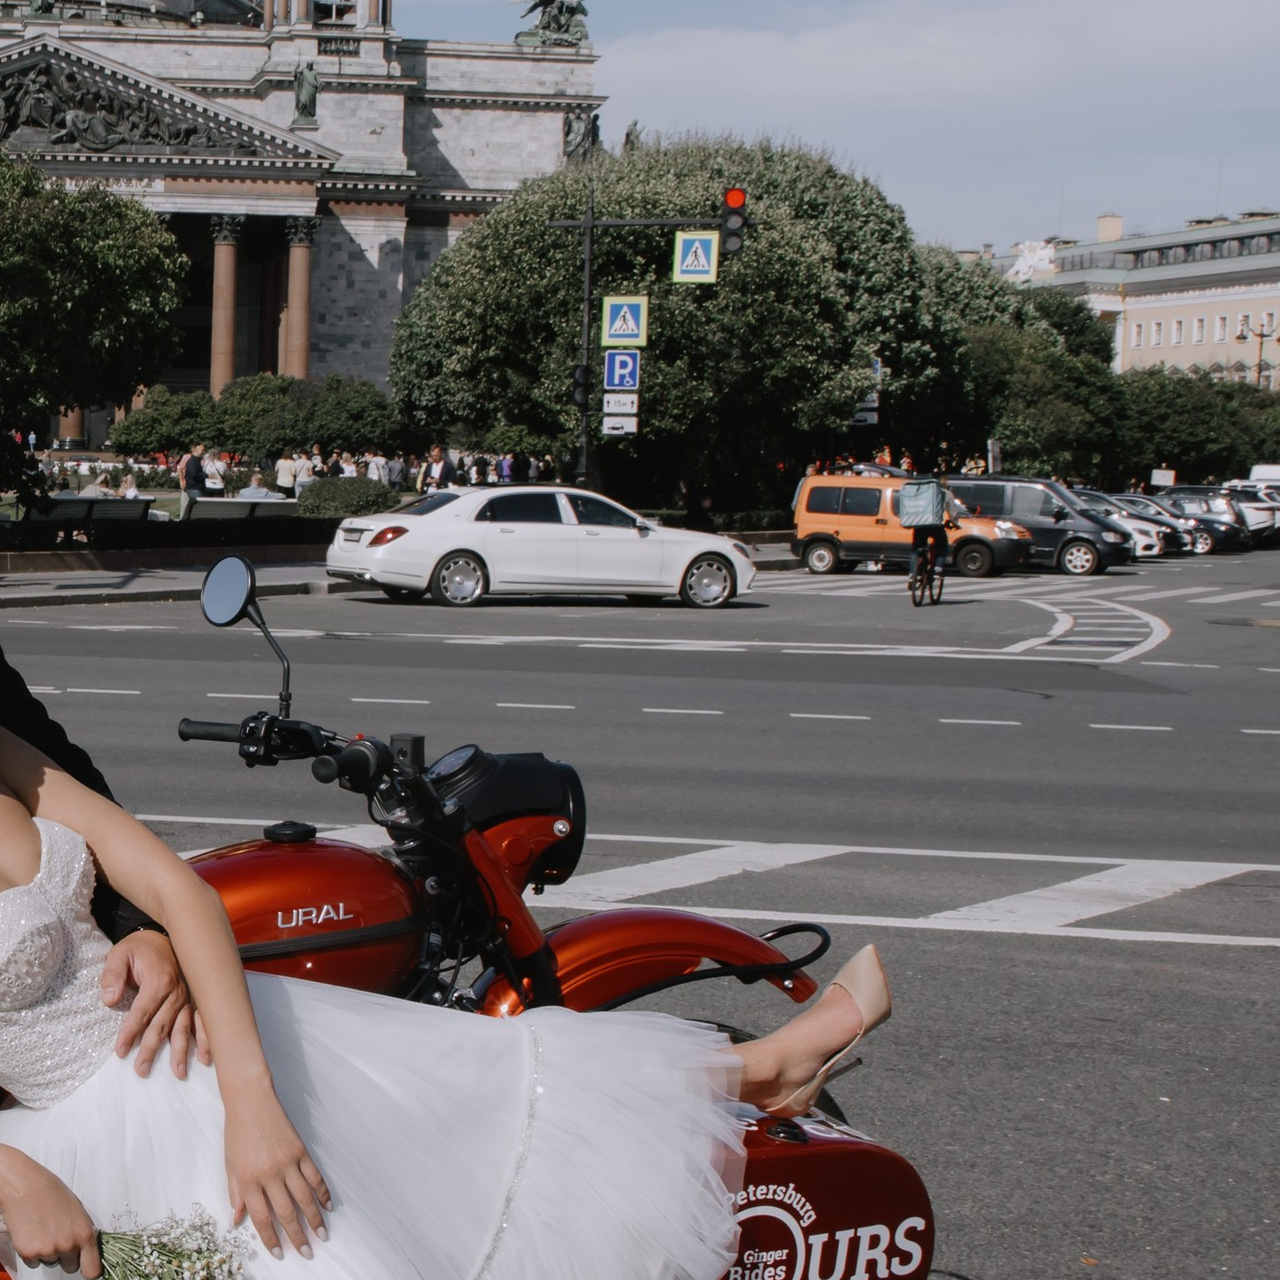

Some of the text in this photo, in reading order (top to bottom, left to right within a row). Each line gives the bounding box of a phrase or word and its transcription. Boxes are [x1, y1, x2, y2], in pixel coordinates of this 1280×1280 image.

[614, 354, 633, 385] P
[277, 902, 354, 928] URAL
[743, 1249, 789, 1264] Ginger
